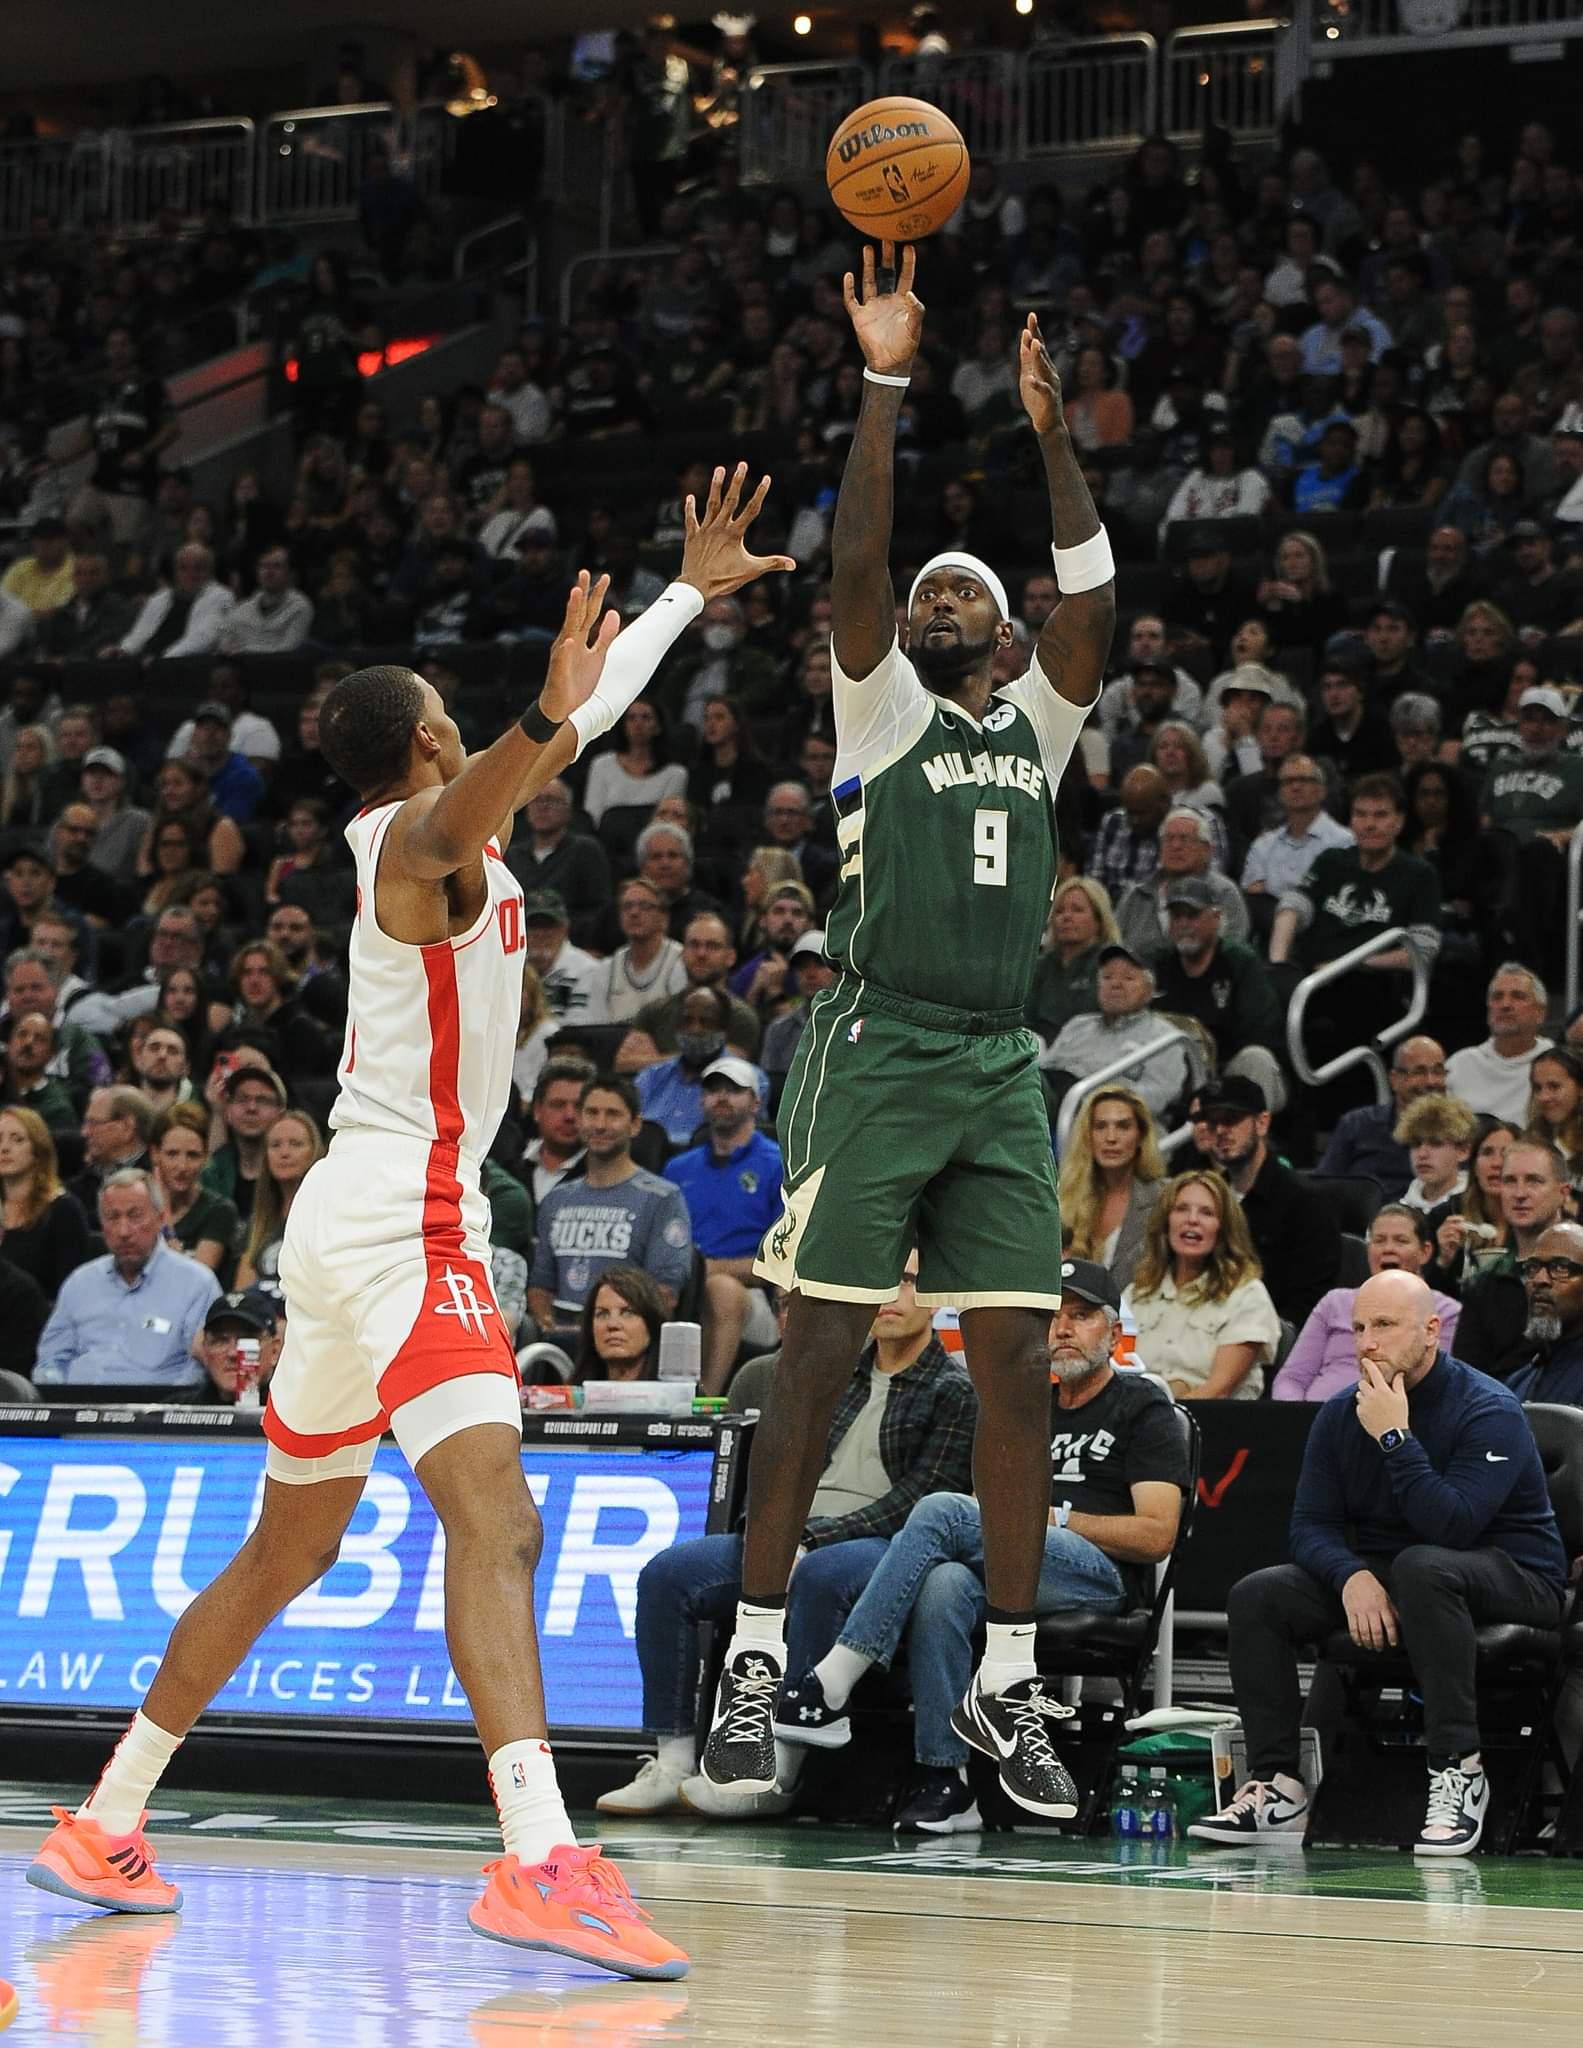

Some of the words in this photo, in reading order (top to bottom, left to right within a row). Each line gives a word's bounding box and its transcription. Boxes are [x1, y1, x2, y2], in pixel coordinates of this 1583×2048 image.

[837, 122, 930, 163] Wilson
[921, 751, 1045, 800] MILAKEE
[973, 808, 1009, 886] 9
[0, 1651, 103, 1691] AW
[129, 1654, 377, 1702] OICES
[404, 1664, 467, 1706] LL
